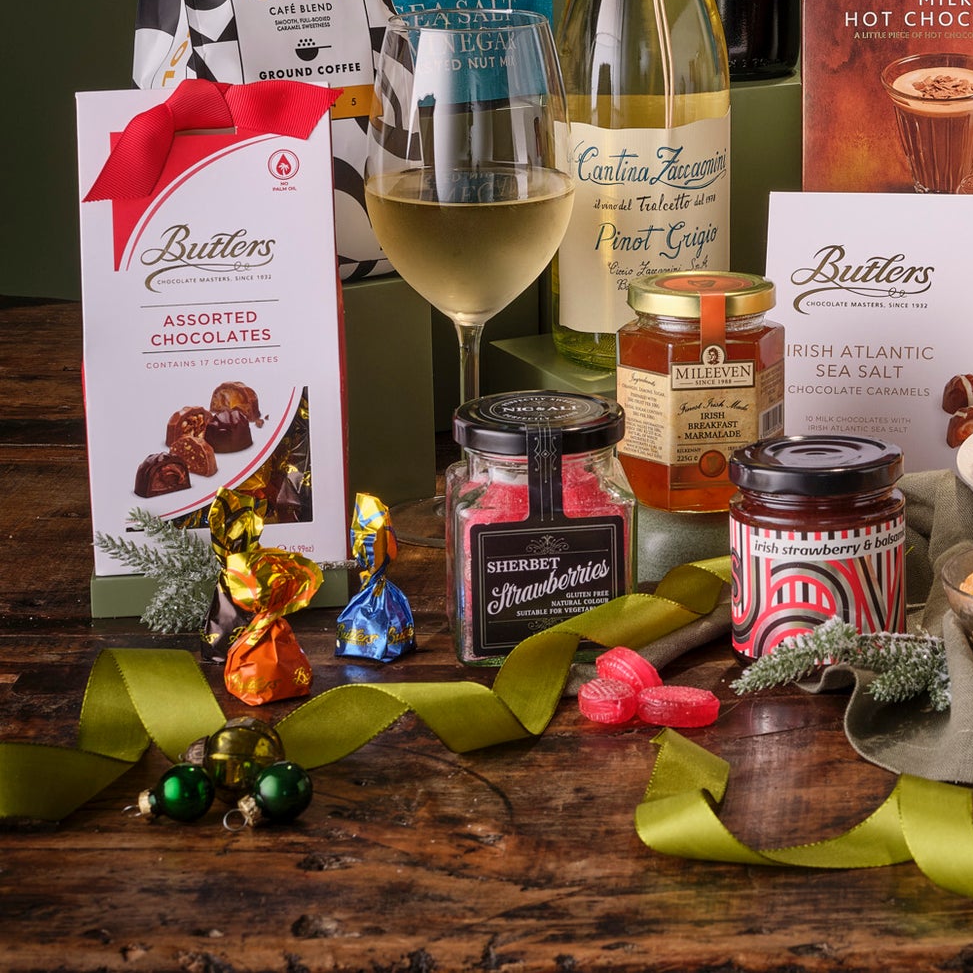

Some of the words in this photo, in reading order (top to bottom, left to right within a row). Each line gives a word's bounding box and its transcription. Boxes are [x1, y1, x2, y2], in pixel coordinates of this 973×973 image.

[269, 3, 296, 15] CAFÉ
[300, 3, 333, 13] BLEND
[845, 12, 892, 27] HOT
[409, 32, 517, 55] VNEGAR
[468, 57, 495, 70] NUT
[259, 67, 312, 80] GROUND
[318, 63, 361, 74] COFFEE
[574, 142, 650, 185] Cantina
[650, 146, 727, 189] Zaccagnini
[636, 193, 692, 211] Tralcetto
[595, 222, 664, 251] Pinot
[660, 221, 719, 259] Grigio
[140, 224, 276, 275] Butlers
[790, 244, 934, 298] Butlers
[163, 311, 257, 327] ASSORTED
[151, 329, 271, 346] CHOCOLATES
[787, 344, 833, 357] IRISH
[840, 345, 934, 360] ATLANTIC
[146, 360, 196, 369] CONTAINS
[213, 356, 278, 366] CHOCOLATES
[676, 365, 751, 379] MILEEVEN
[816, 364, 851, 377] SEA
[859, 365, 903, 378] SALT
[788, 385, 862, 394] CHOCOLATE
[867, 387, 930, 396] CARAMELS
[688, 421, 738, 430] BREAKFAST
[684, 430, 741, 440] MARMALADE
[755, 540, 778, 554] irish
[782, 543, 860, 555] strawberry
[864, 540, 872, 550] &
[487, 557, 560, 573] SHERBET
[487, 559, 610, 615] Strawberries
[552, 599, 580, 607] NATURAL
[584, 597, 609, 605] COLOUR
[517, 609, 547, 617] SUITABLE
